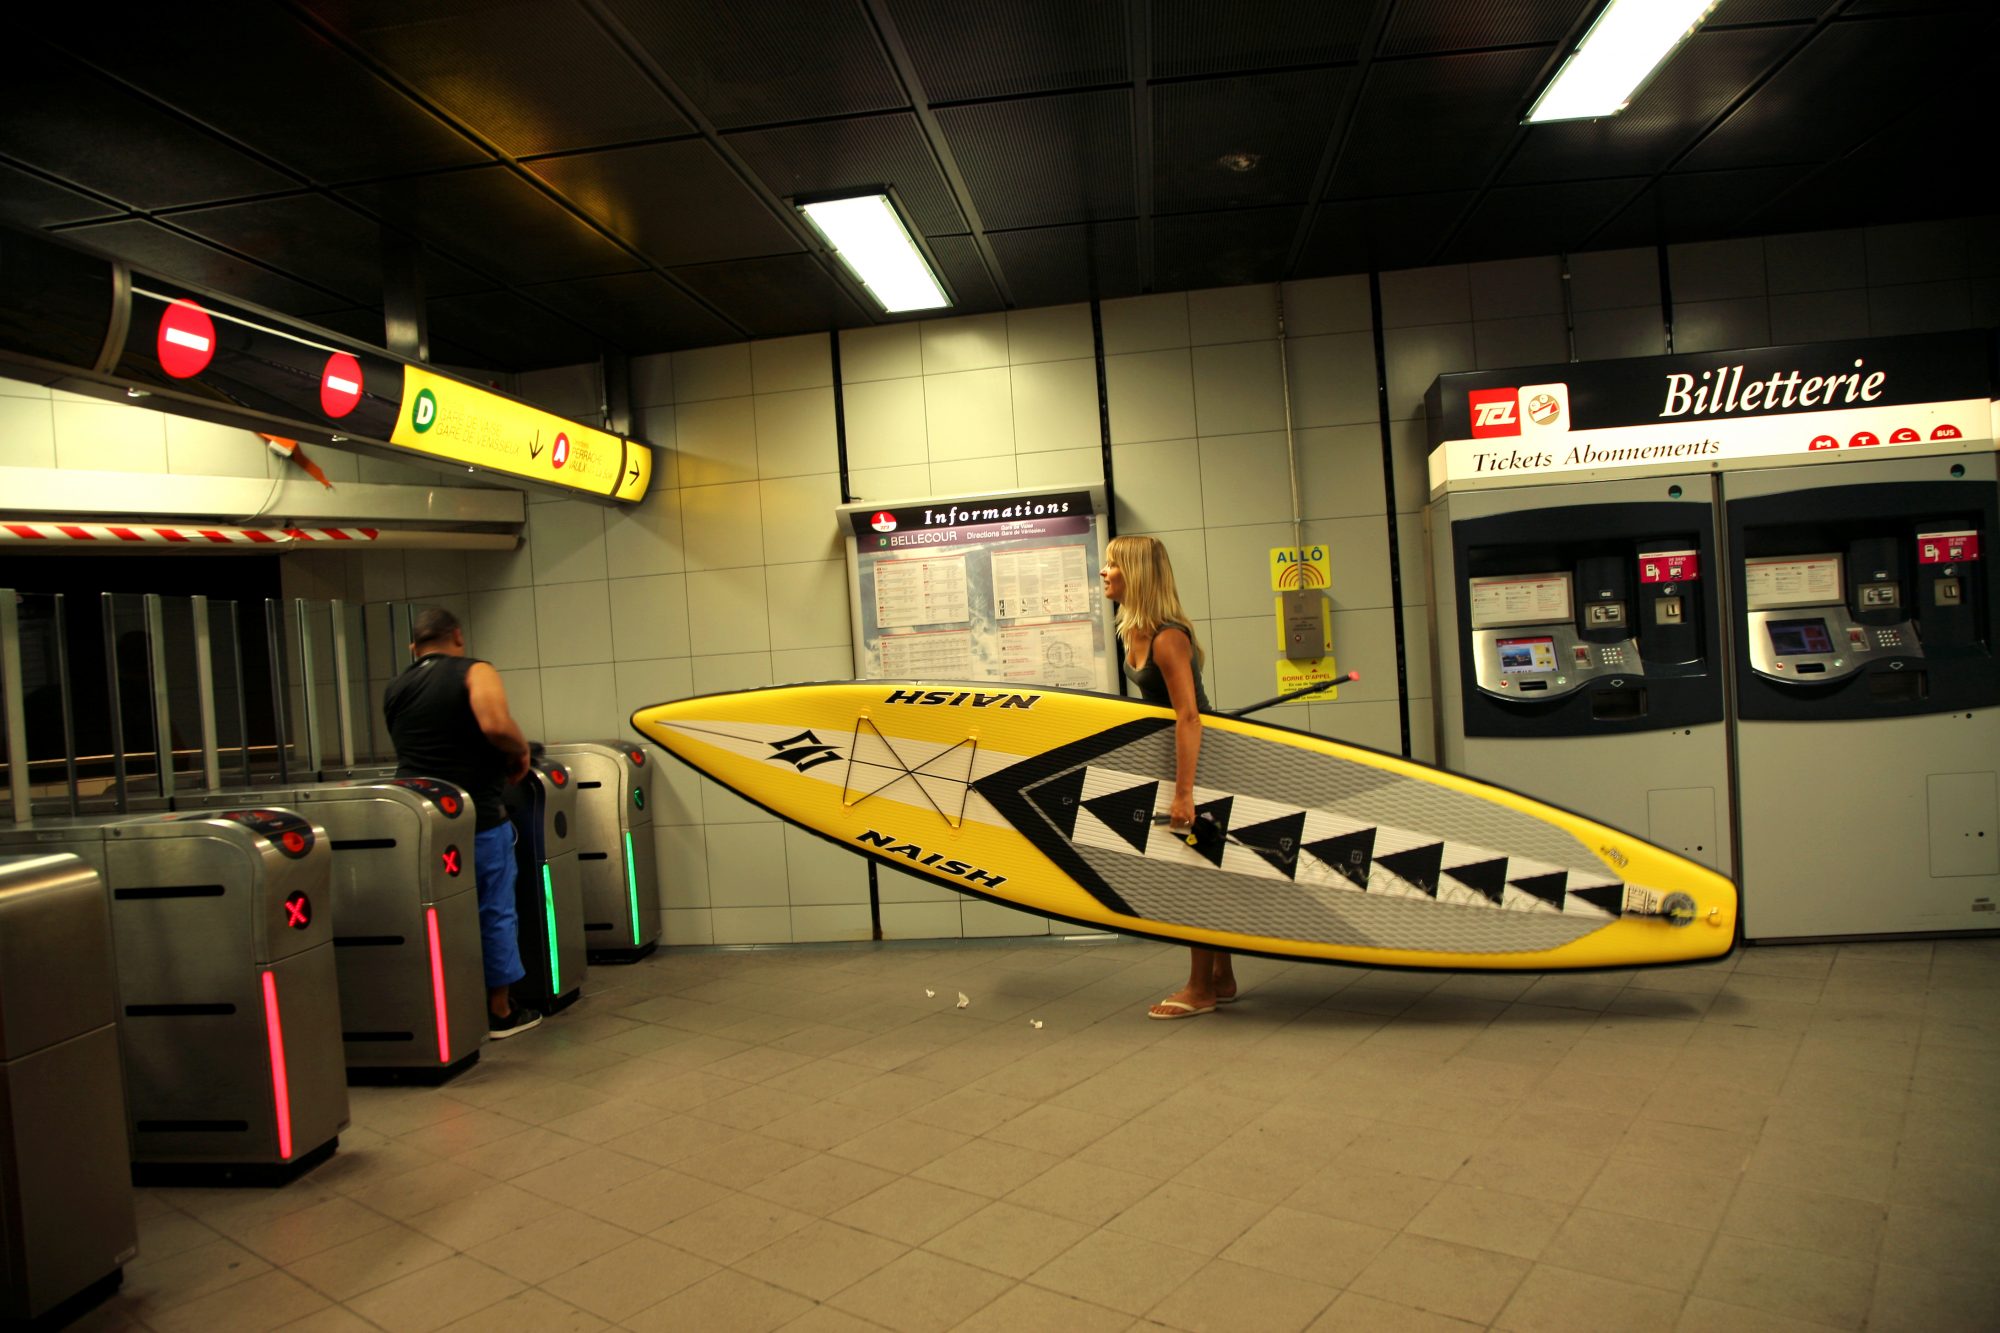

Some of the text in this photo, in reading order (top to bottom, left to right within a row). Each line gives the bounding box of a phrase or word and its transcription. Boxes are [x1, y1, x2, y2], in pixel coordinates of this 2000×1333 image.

[1659, 358, 1886, 417] Billetterie
[416, 396, 434, 425] D
[1474, 400, 1517, 427] TCL
[435, 421, 463, 440] GARE
[462, 428, 475, 445] DE
[1857, 436, 1871, 445] T
[1896, 431, 1912, 441] C
[1936, 428, 1955, 438] BUS
[553, 439, 566, 463] A
[1473, 437, 1720, 472] Tickets Abonnements
[1814, 440, 1832, 449] M
[571, 445, 603, 466] PERRACHE
[924, 500, 1070, 526] Informations
[890, 530, 958, 547] BELLECOUR
[966, 530, 1000, 540] Directions
[1276, 546, 1323, 563] ALLÔ
[1282, 672, 1331, 683] BORNE D'APPEL
[884, 690, 1042, 709] NAISH
[855, 829, 1007, 889] NAISH
